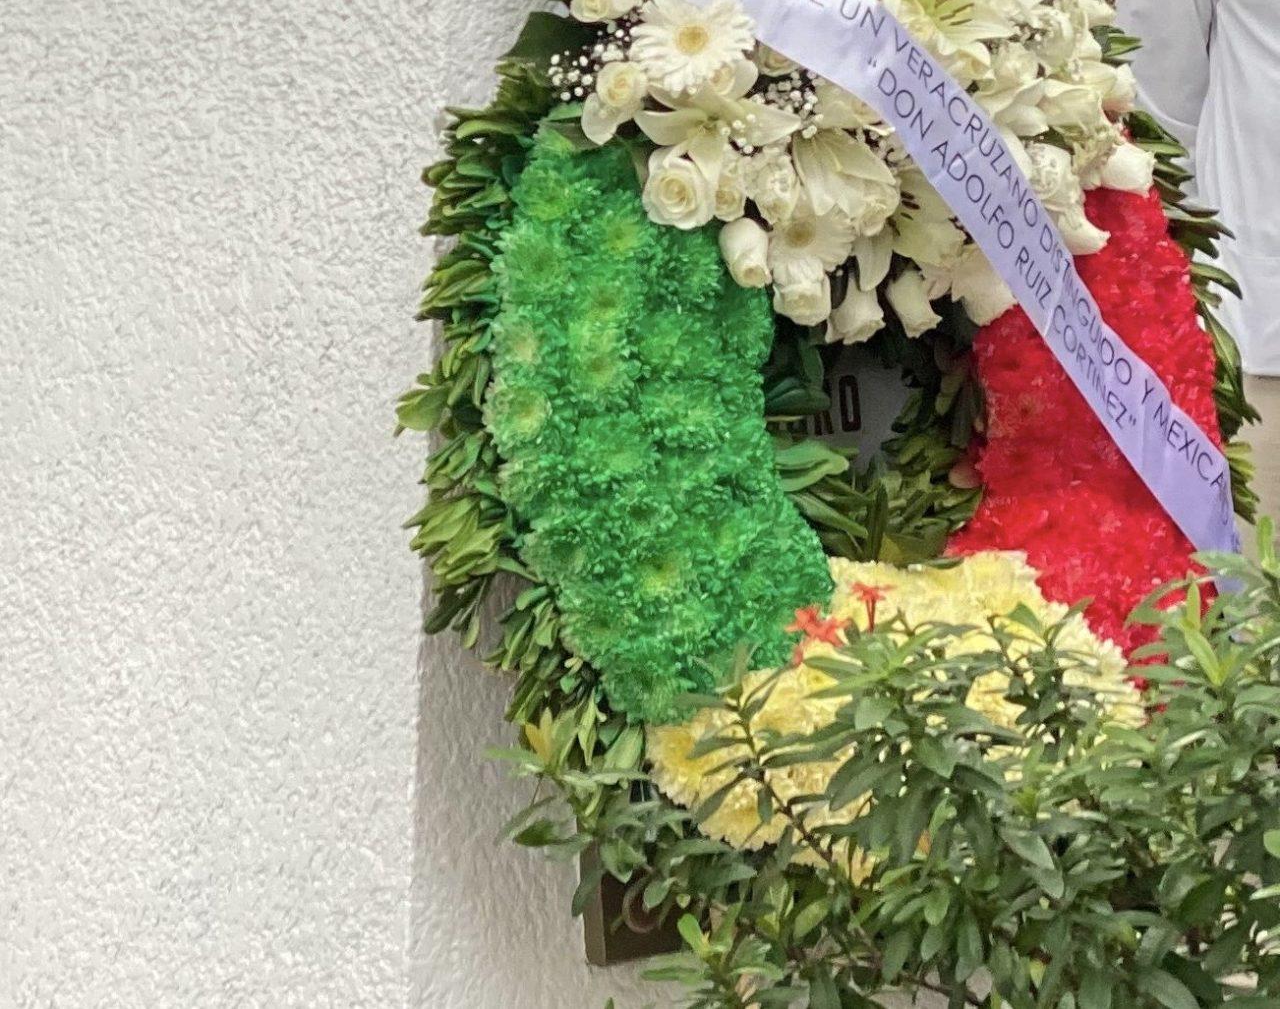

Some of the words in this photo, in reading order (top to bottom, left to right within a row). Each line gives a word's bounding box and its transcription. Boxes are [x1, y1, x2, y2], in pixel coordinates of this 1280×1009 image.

[894, 28, 1038, 228] VERACRUZANO
[1141, 379, 1154, 405] Y
[931, 140, 1015, 250] ADOLFO
[1015, 246, 1052, 310] RUIZ
